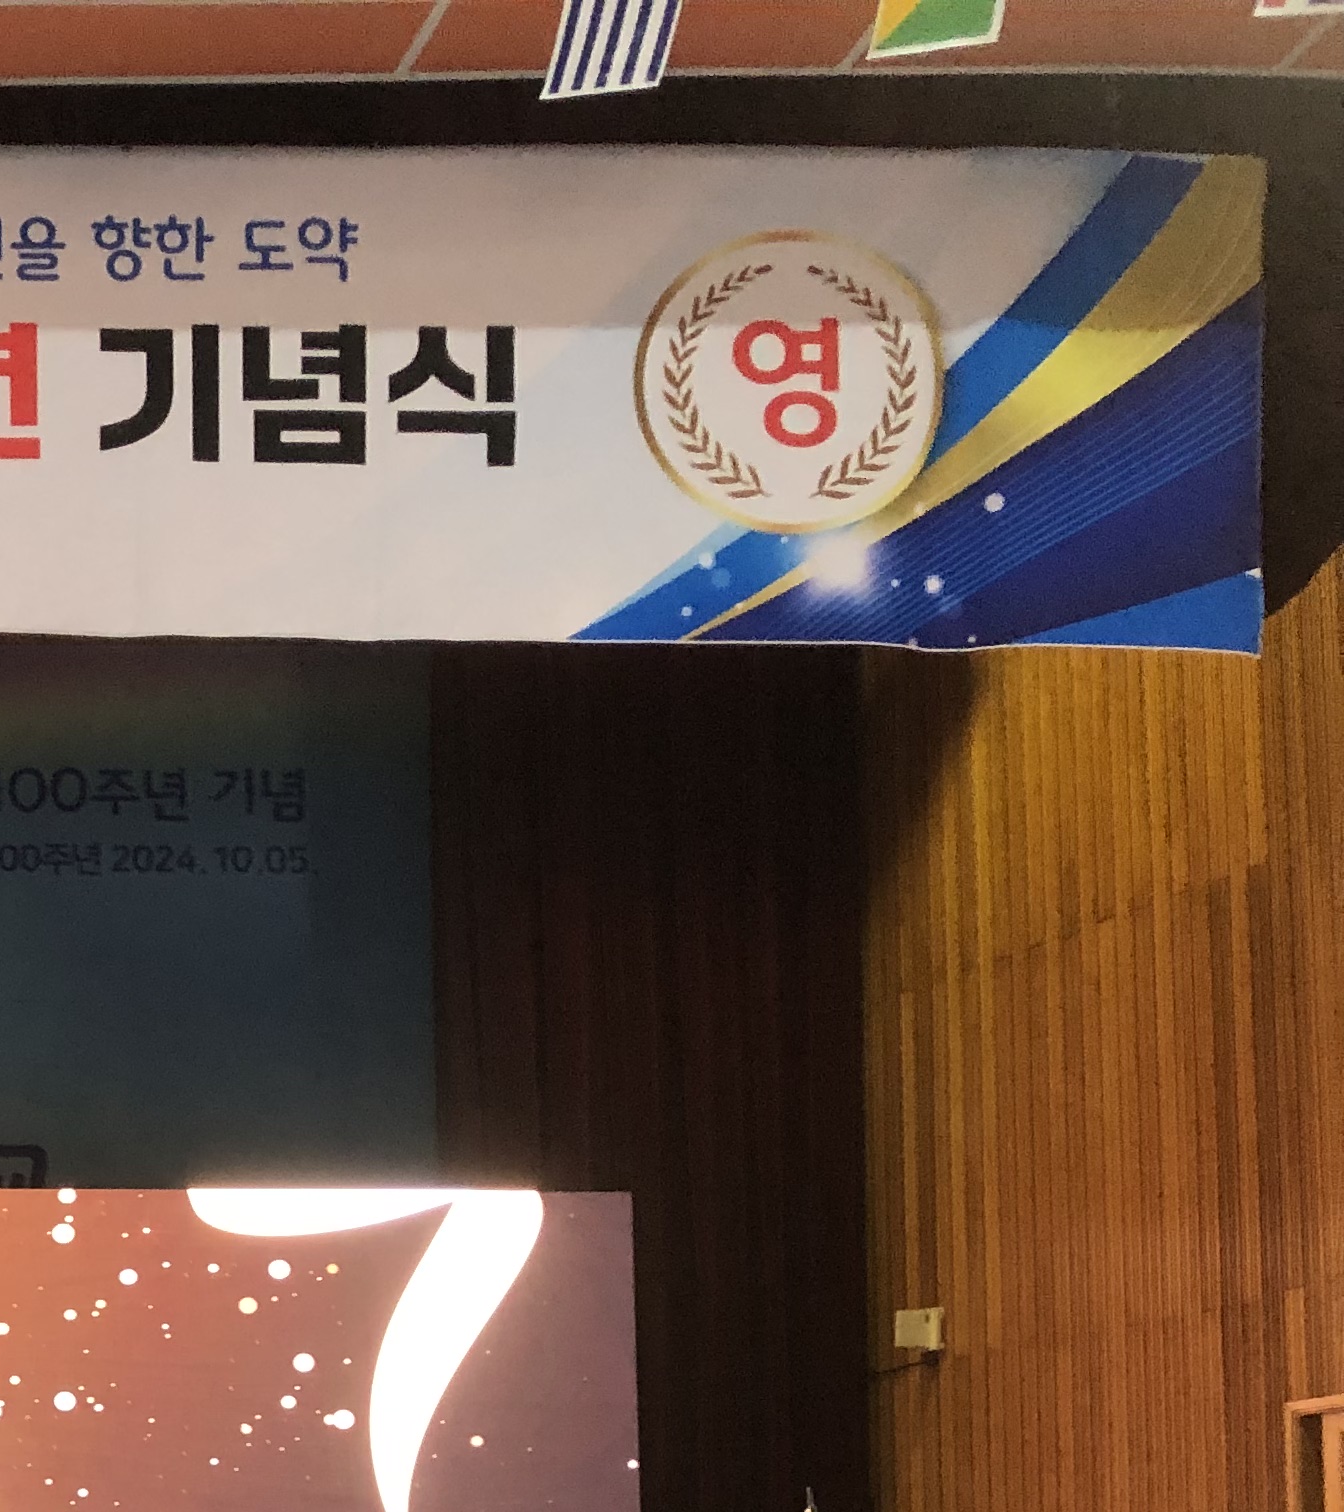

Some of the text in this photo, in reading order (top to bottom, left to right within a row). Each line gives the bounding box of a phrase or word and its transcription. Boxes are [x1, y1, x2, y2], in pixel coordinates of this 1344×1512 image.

[92, 213, 215, 284] 향한
[237, 213, 361, 284] 도약
[97, 321, 518, 468] 기념식
[732, 317, 841, 449] 영
[208, 767, 307, 823] 기념
